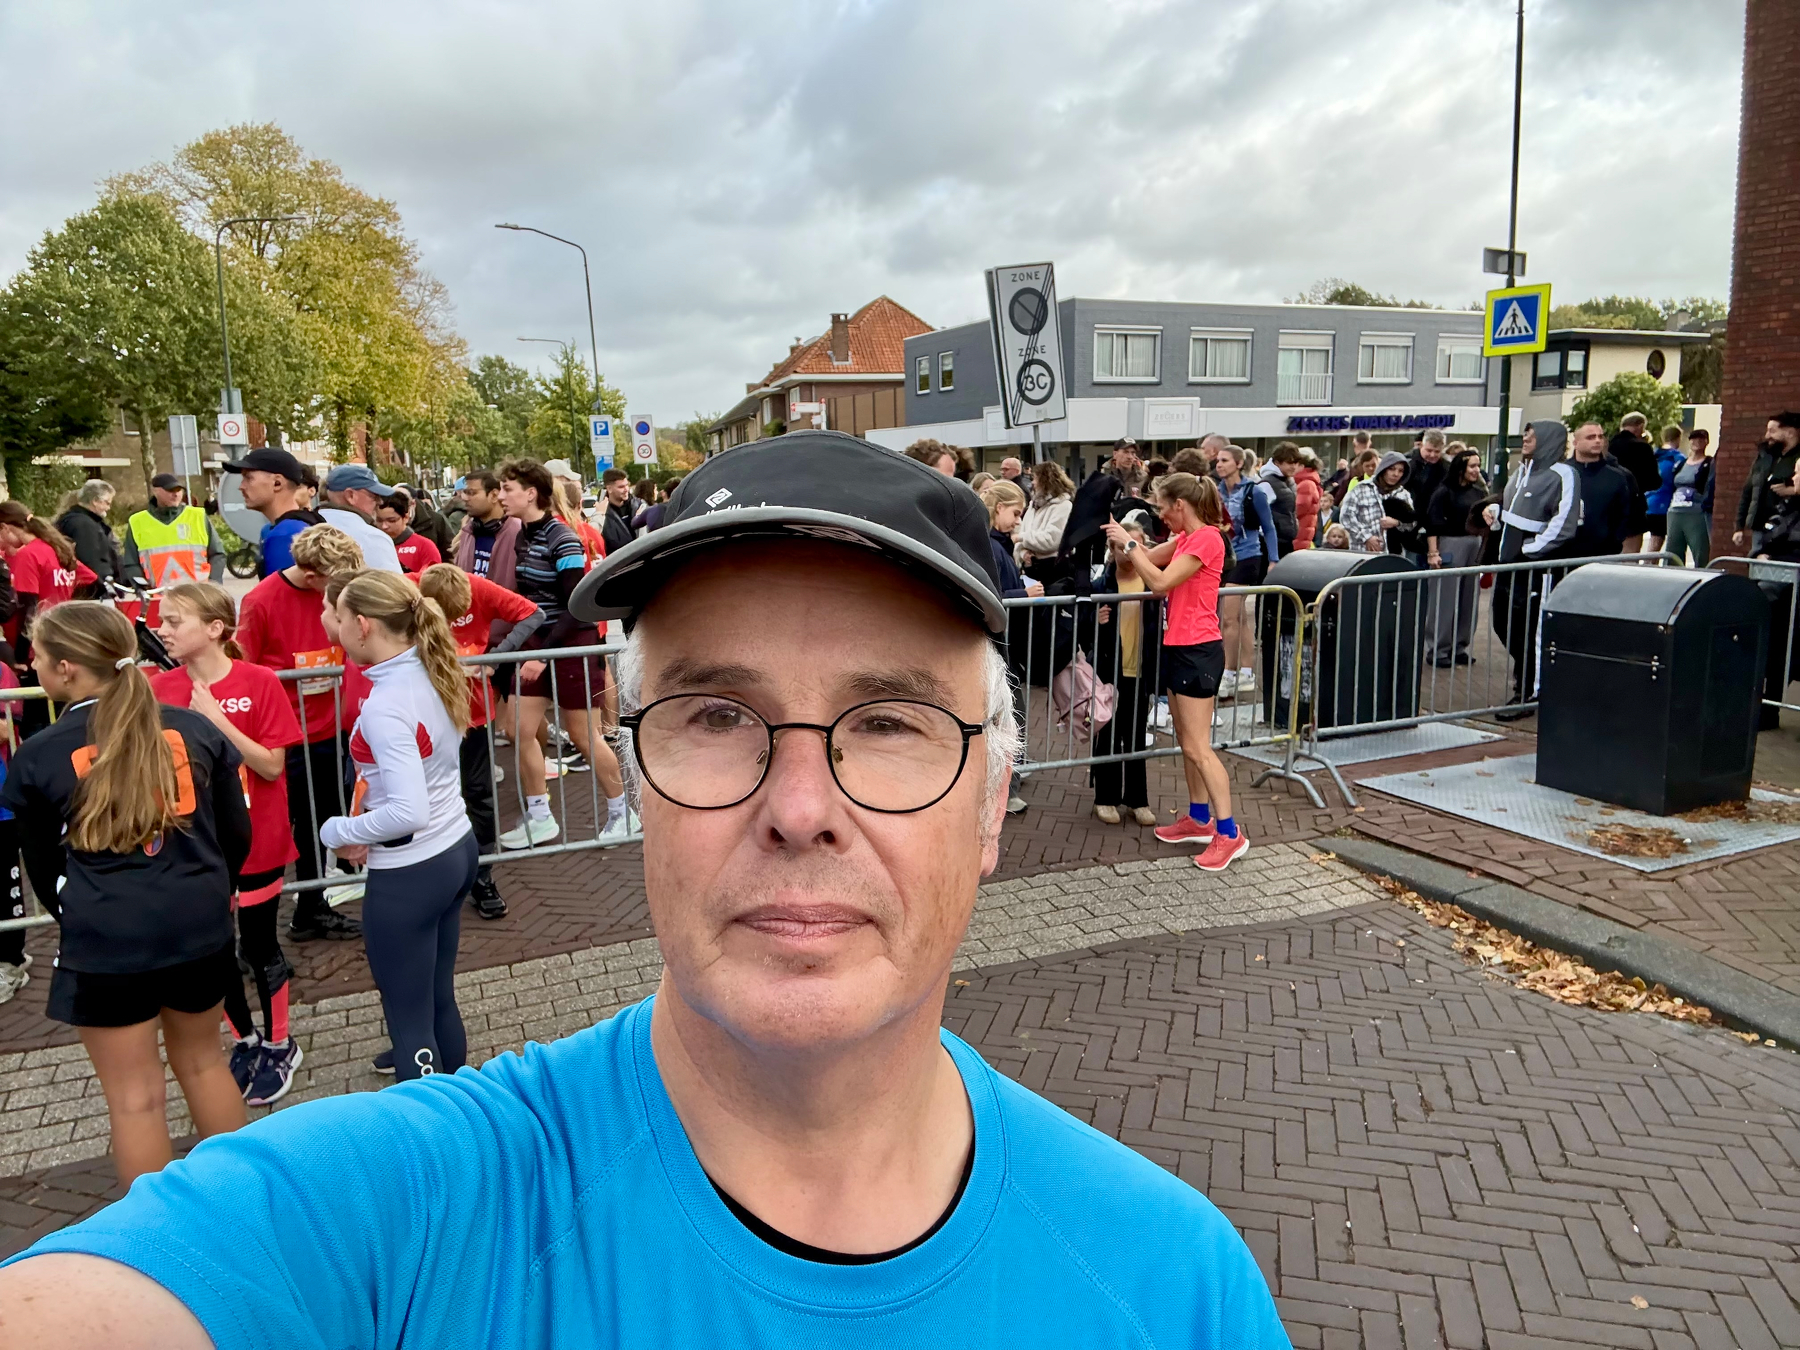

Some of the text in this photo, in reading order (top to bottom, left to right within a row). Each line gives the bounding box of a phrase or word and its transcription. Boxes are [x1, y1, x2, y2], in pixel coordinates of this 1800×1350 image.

[1011, 271, 1041, 282] ZONE
[1018, 345, 1046, 357] ZONE
[596, 422, 606, 435] P
[1287, 415, 1350, 431] ZEGERS
